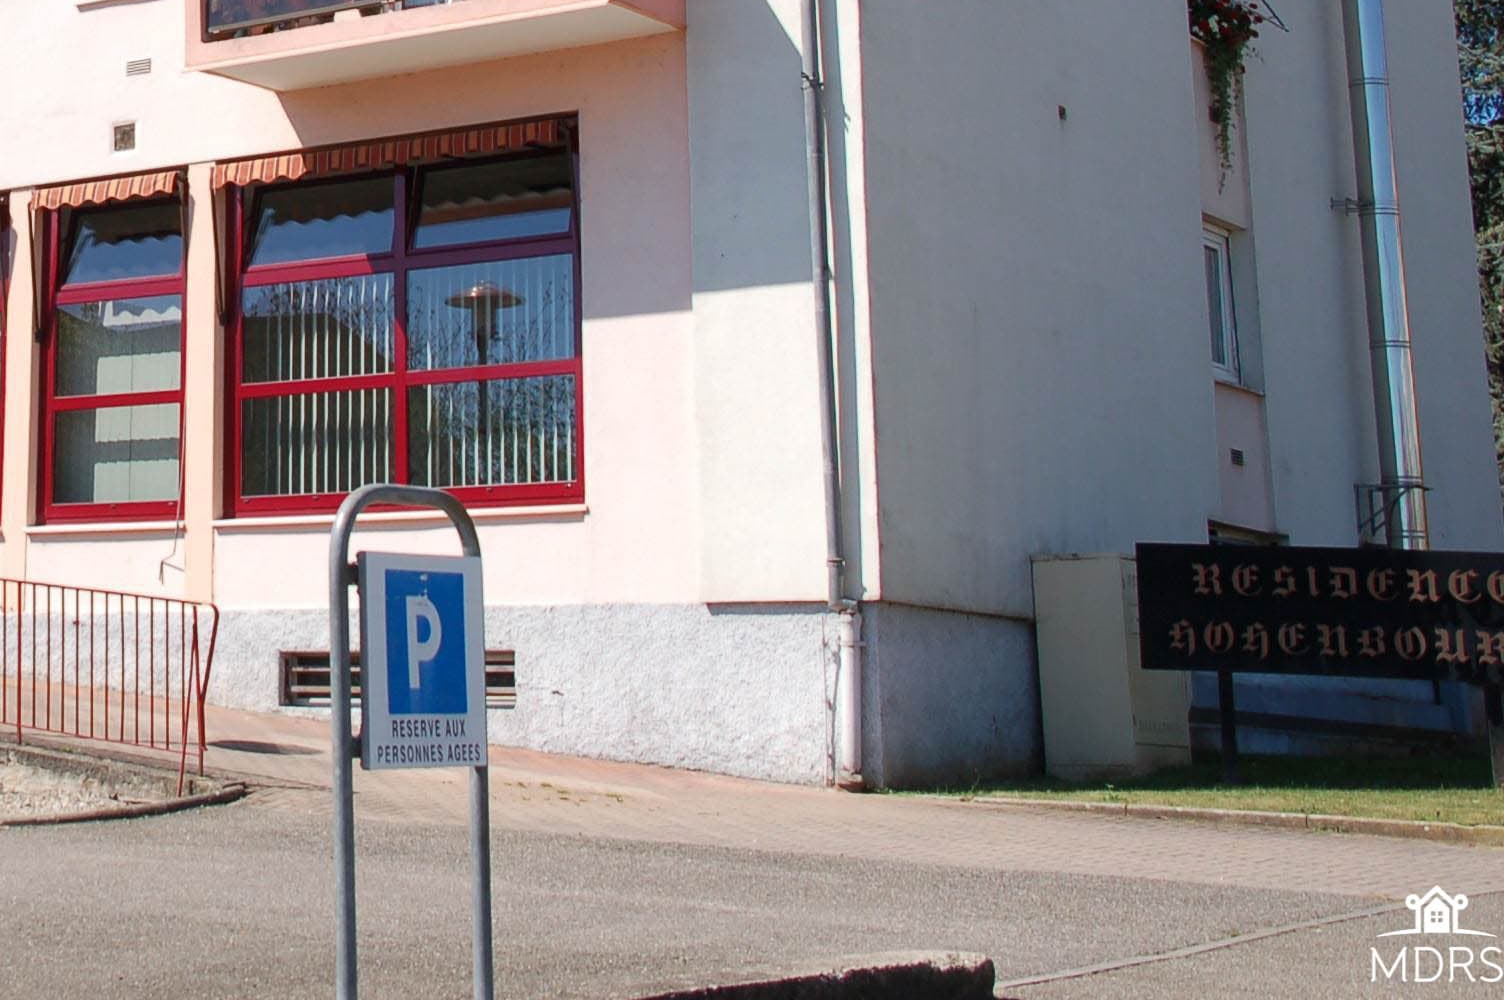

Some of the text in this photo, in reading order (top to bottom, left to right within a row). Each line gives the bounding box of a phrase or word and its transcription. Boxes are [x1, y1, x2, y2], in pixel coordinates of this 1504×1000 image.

[406, 595, 442, 690] P
[392, 719, 465, 738] RESERVE AUX
[377, 743, 481, 763] PERSONNES AGEES
